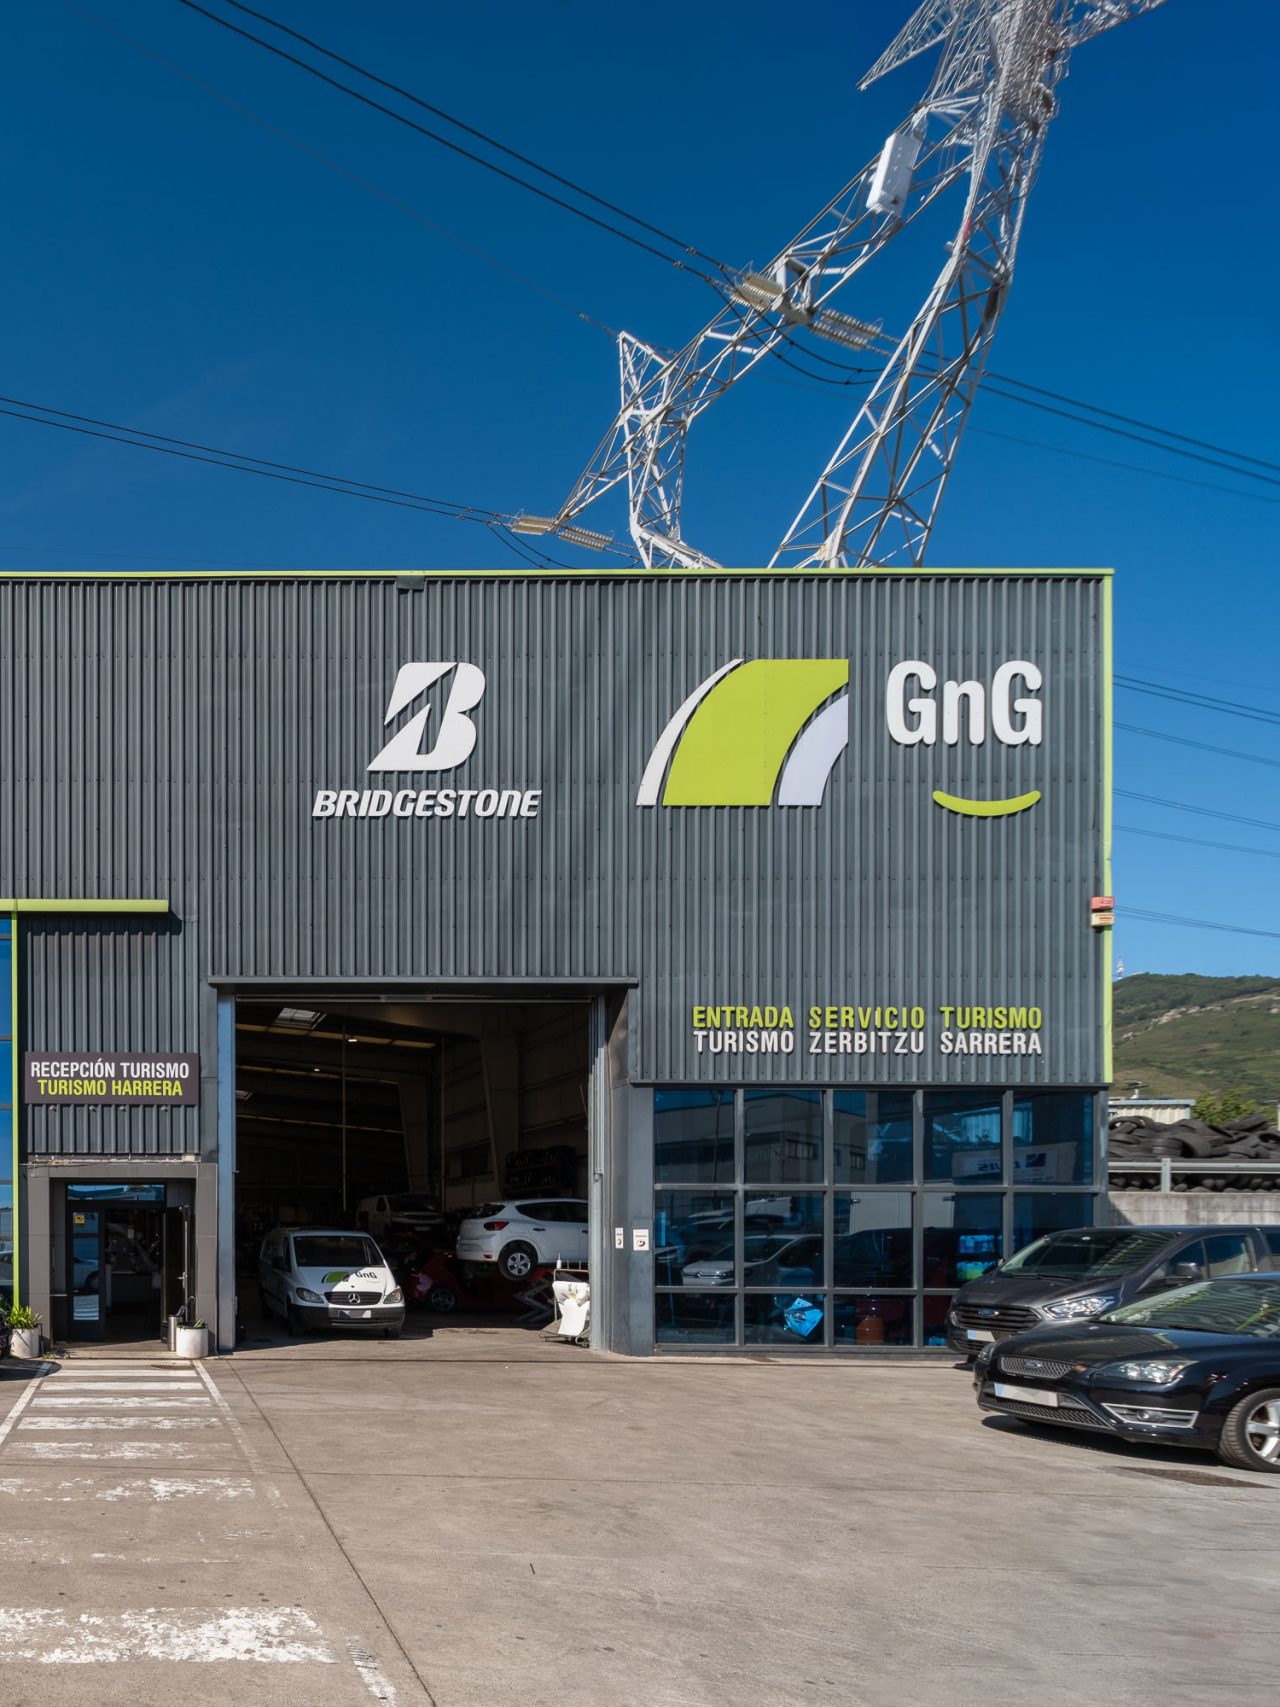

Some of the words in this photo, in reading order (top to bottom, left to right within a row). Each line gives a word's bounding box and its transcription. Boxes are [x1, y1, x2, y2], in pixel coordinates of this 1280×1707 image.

[886, 660, 1042, 746] GnG
[312, 789, 543, 818] BRIDGESTONE
[693, 1006, 794, 1030] ENTRADA
[808, 1006, 925, 1030] SERVICIO
[940, 1007, 1042, 1030] TURISMO
[693, 1030, 794, 1054] TURISMO
[809, 1031, 925, 1055] ZERBITZU
[940, 1031, 1042, 1056] SARRERA
[30, 1058, 115, 1078] RECEPCIÓN
[121, 1062, 190, 1079] TURISMO
[37, 1079, 107, 1097] TURISMO
[111, 1080, 183, 1097] HARRERA
[355, 1271, 378, 1280] GnG
